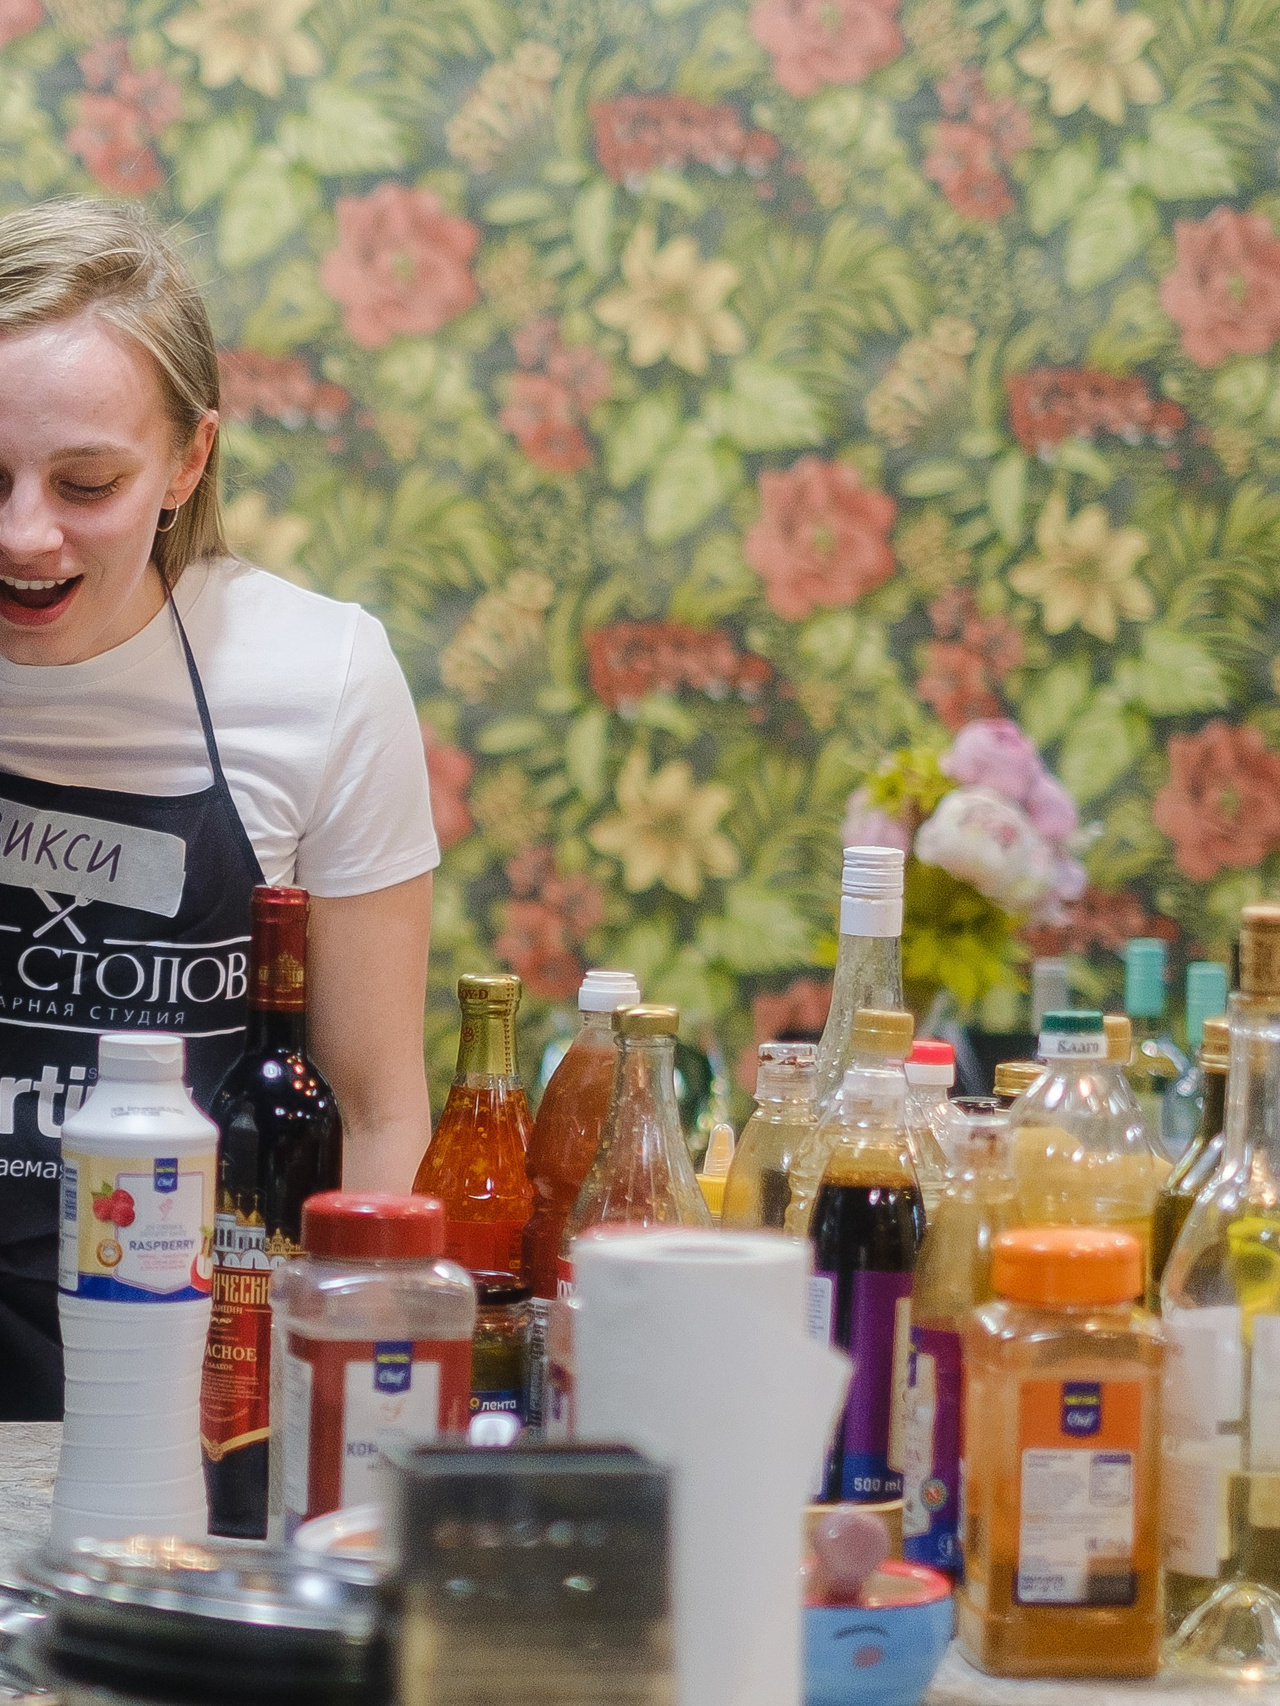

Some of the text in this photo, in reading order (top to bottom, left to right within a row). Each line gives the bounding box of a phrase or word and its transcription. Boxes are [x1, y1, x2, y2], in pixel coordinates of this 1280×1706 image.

[18, 945, 248, 1004] СТОЛОВ
[89, 1005, 186, 1026] СТУДИЯ
[128, 1239, 195, 1251] RASPBERRY
[481, 1399, 517, 1411] лента
[853, 1477, 881, 1492] 500
